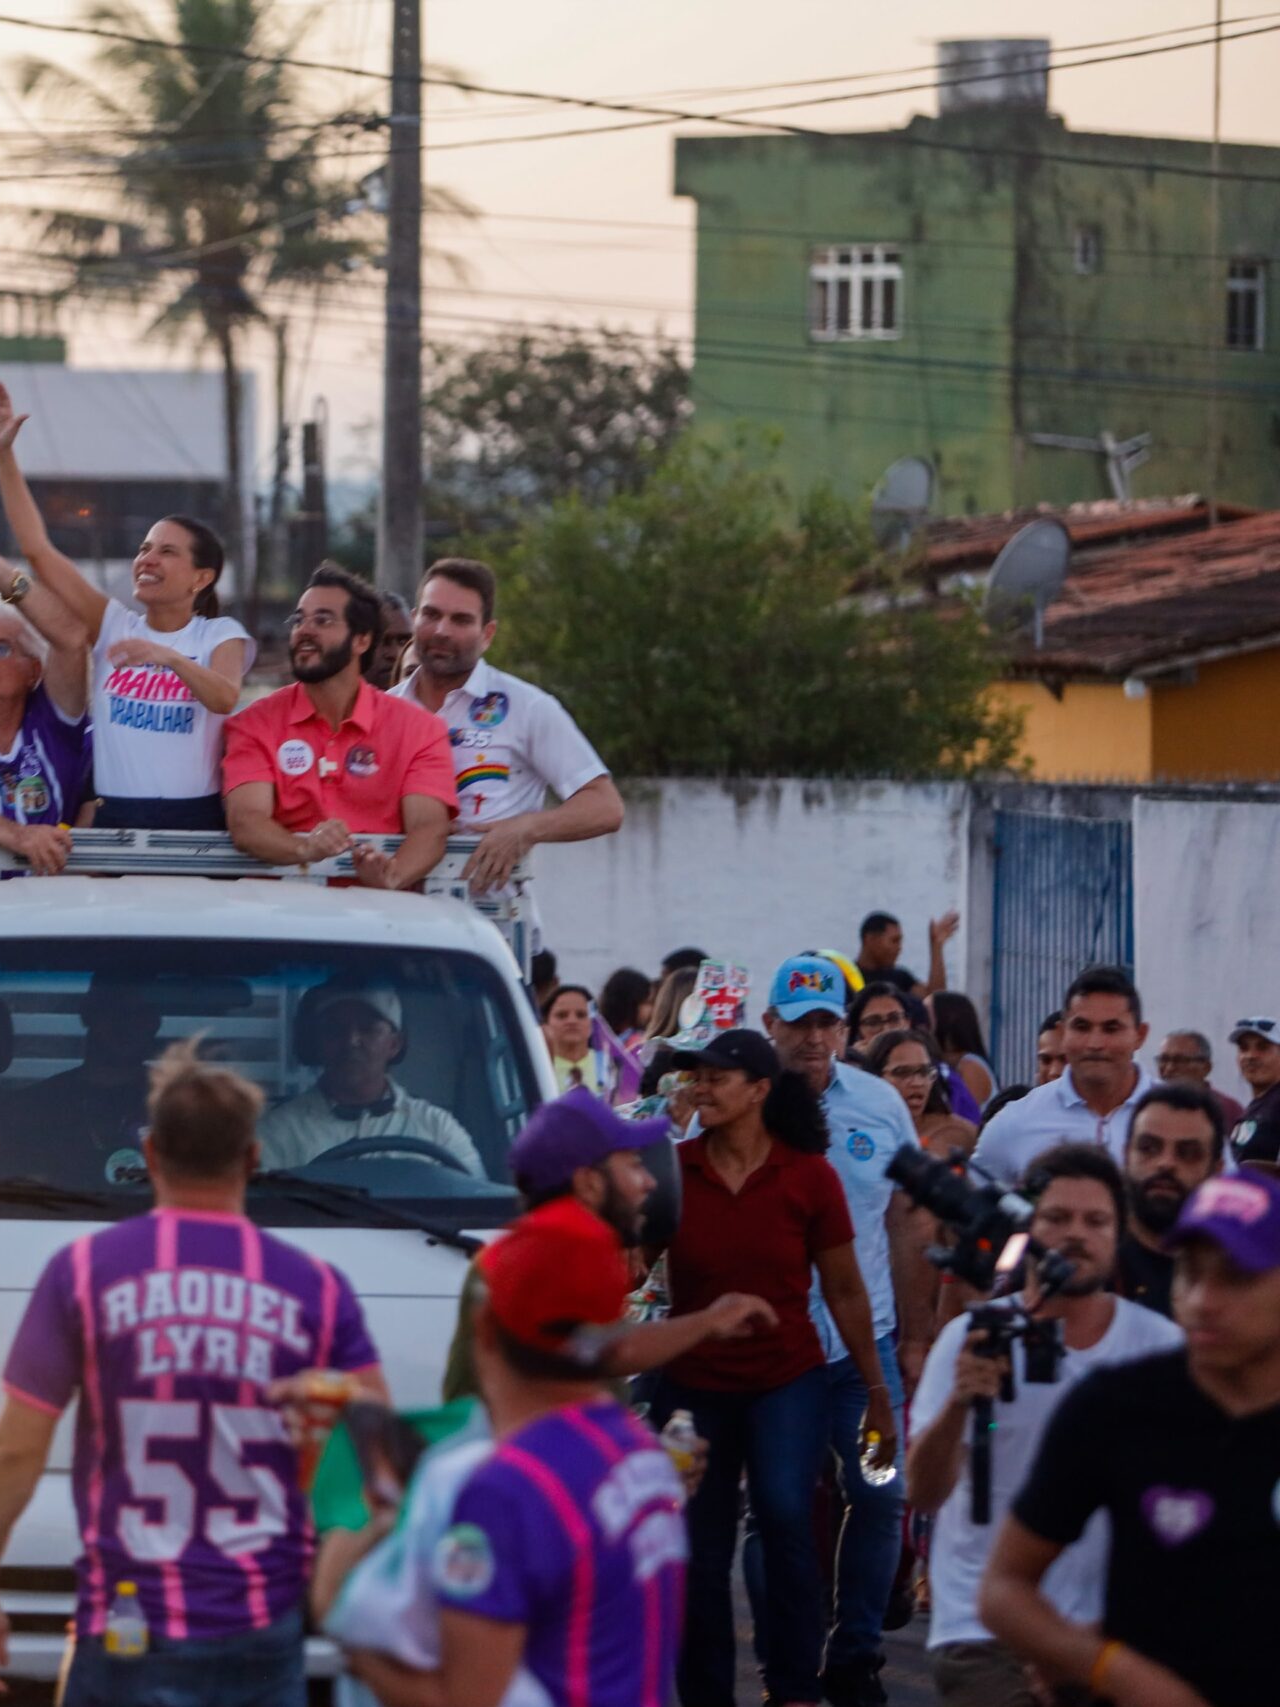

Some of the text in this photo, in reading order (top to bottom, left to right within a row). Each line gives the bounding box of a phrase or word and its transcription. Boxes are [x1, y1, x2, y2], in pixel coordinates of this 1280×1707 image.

[103, 667, 195, 702] MAINH
[110, 695, 195, 734] TRABALHAR
[464, 730, 492, 748] 55
[138, 1324, 272, 1385] LYRA
[117, 1400, 292, 1561] 55
